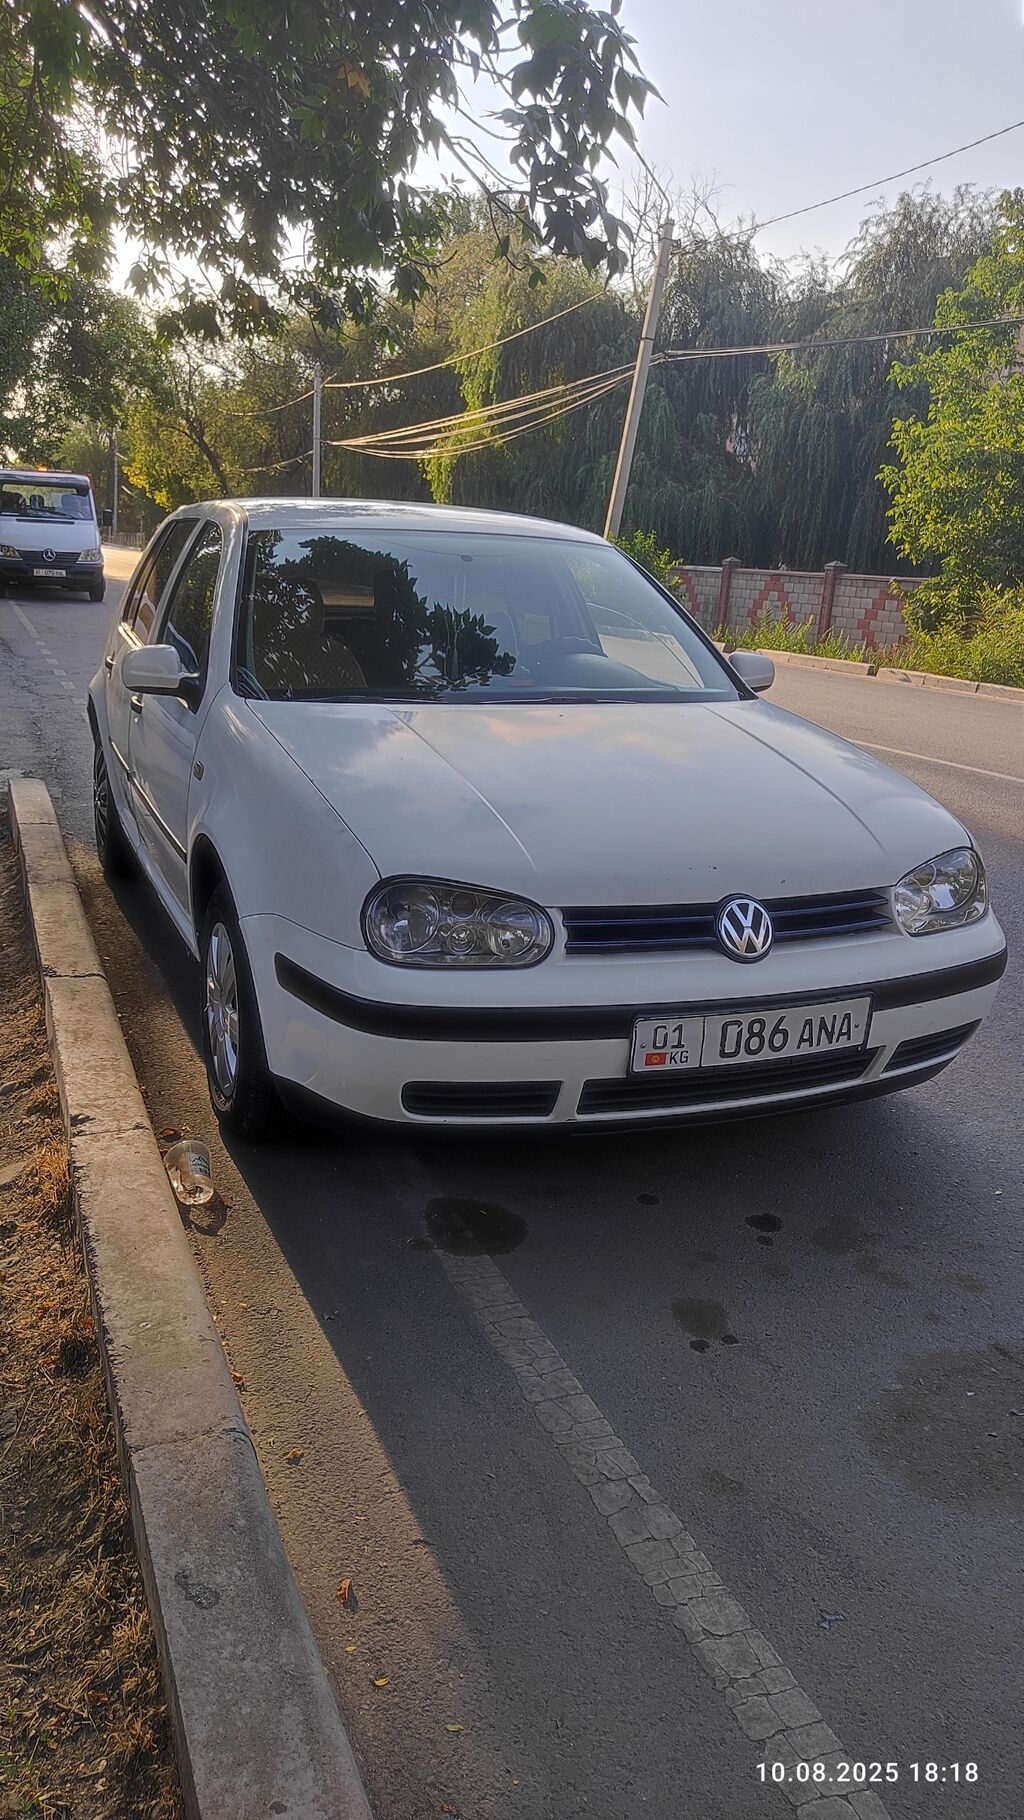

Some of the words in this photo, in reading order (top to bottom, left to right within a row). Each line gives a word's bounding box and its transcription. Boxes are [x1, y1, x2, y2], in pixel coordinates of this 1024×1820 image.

[721, 899, 772, 956] VW
[653, 1023, 685, 1050] 01
[719, 1016, 789, 1058] 086
[796, 1012, 853, 1050] ANA
[669, 1050, 689, 1065] KG
